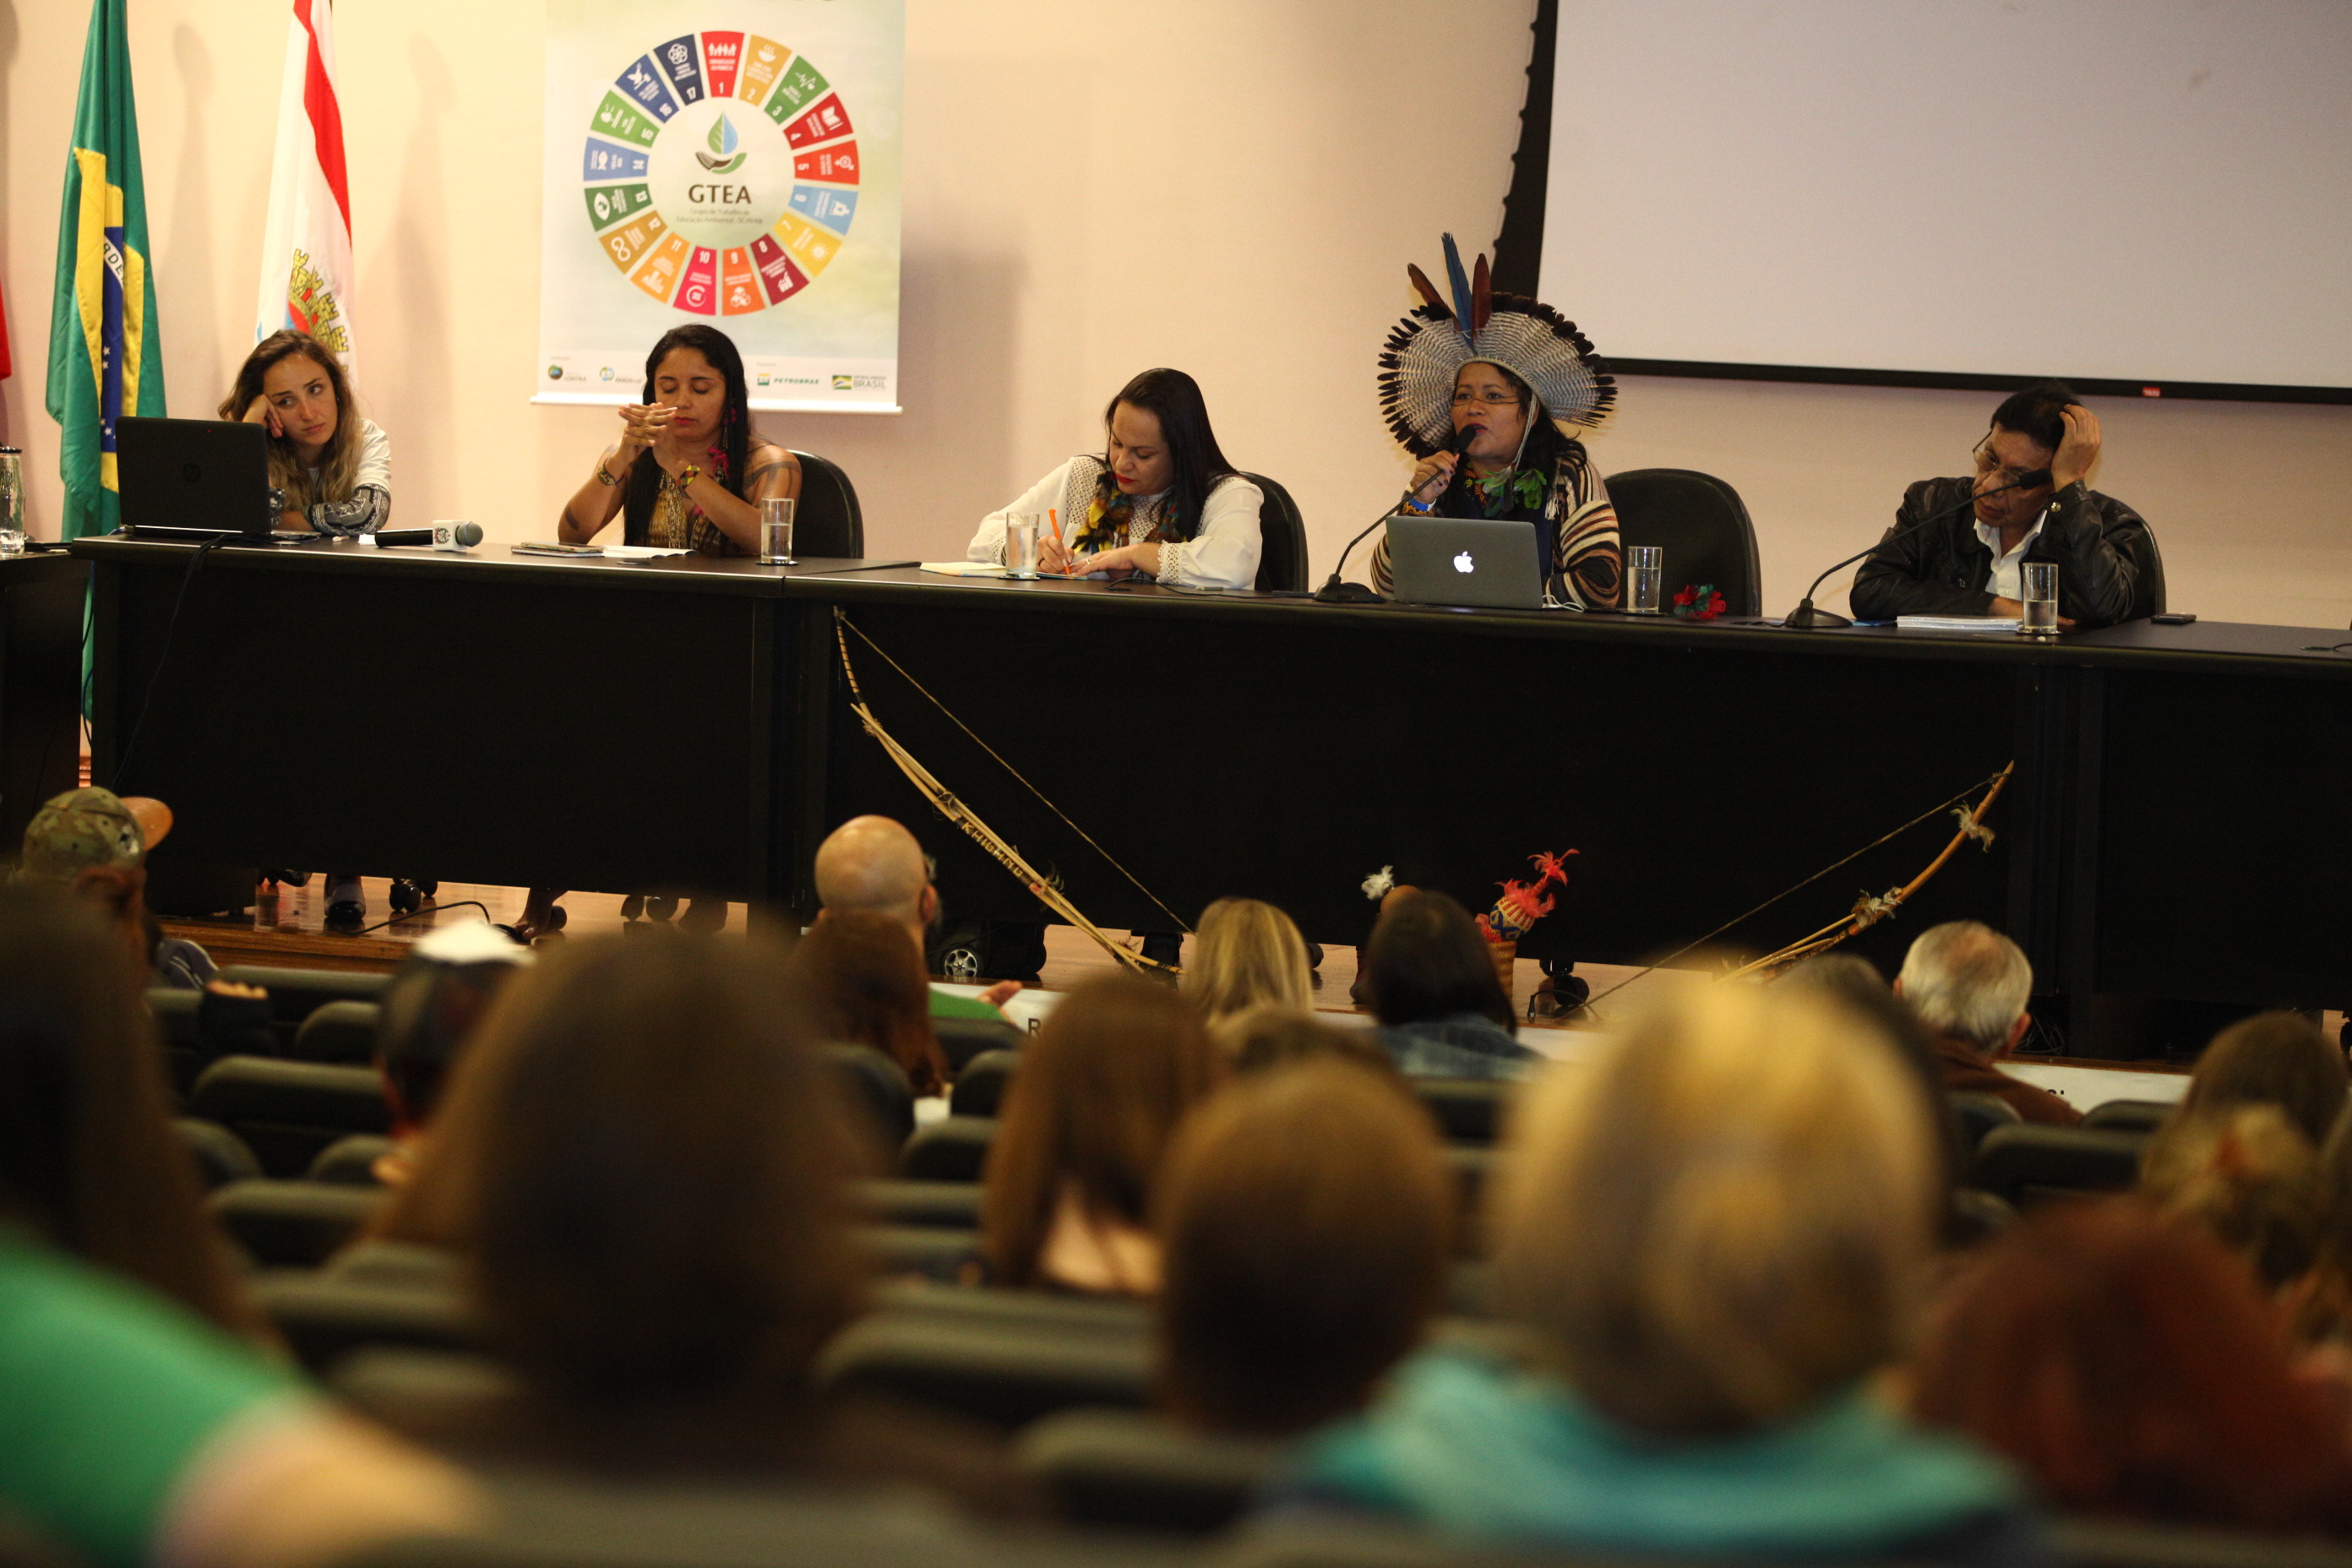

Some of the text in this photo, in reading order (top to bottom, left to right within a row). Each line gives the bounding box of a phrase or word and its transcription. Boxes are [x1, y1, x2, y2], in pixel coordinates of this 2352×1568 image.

[686, 86, 697, 101] 17
[718, 82, 724, 95] 1
[747, 87, 757, 101] 2
[772, 105, 783, 117] 3
[797, 162, 810, 171] 5
[688, 184, 752, 204] GTEA
[781, 220, 792, 231] 7
[759, 240, 768, 253] 8
[699, 250, 710, 264] 10
[731, 252, 738, 264] 9
[853, 380, 886, 389] BRASIL
